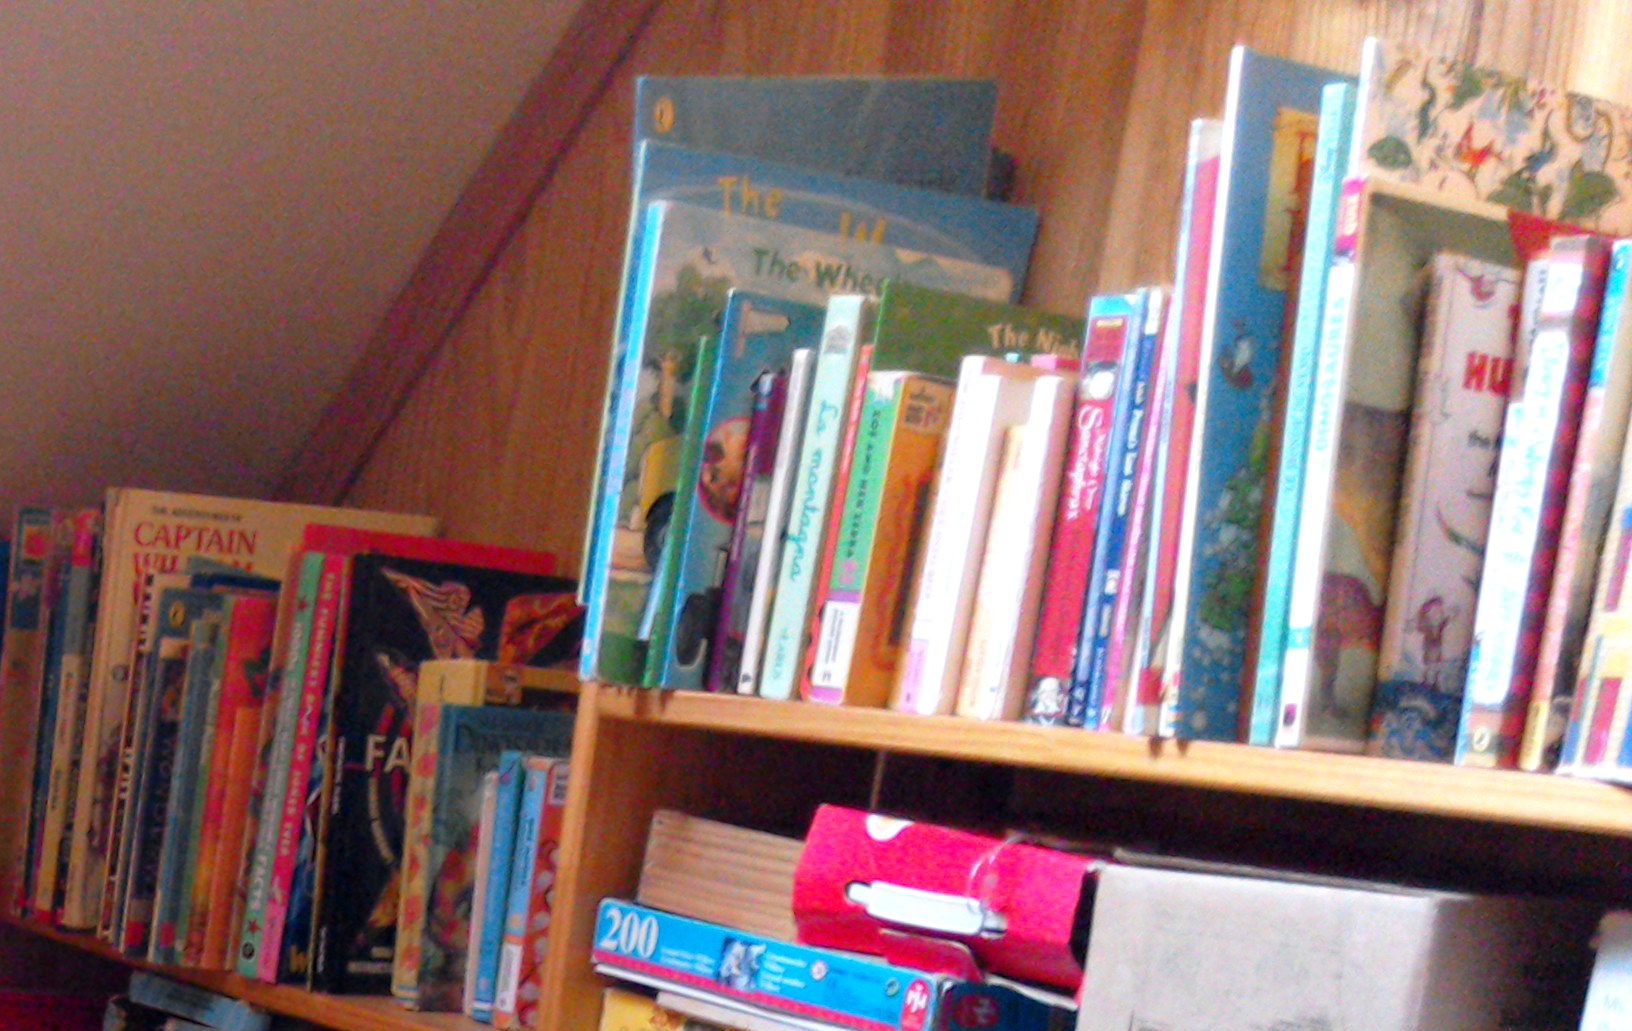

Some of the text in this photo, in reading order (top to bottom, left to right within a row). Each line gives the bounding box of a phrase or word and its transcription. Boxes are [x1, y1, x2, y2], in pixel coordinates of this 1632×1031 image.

[718, 175, 784, 218] The
[754, 248, 800, 282] The
[987, 323, 1028, 350] The
[134, 520, 257, 555] CAPTAIN
[365, 734, 410, 774] FA
[599, 907, 659, 960] 200
